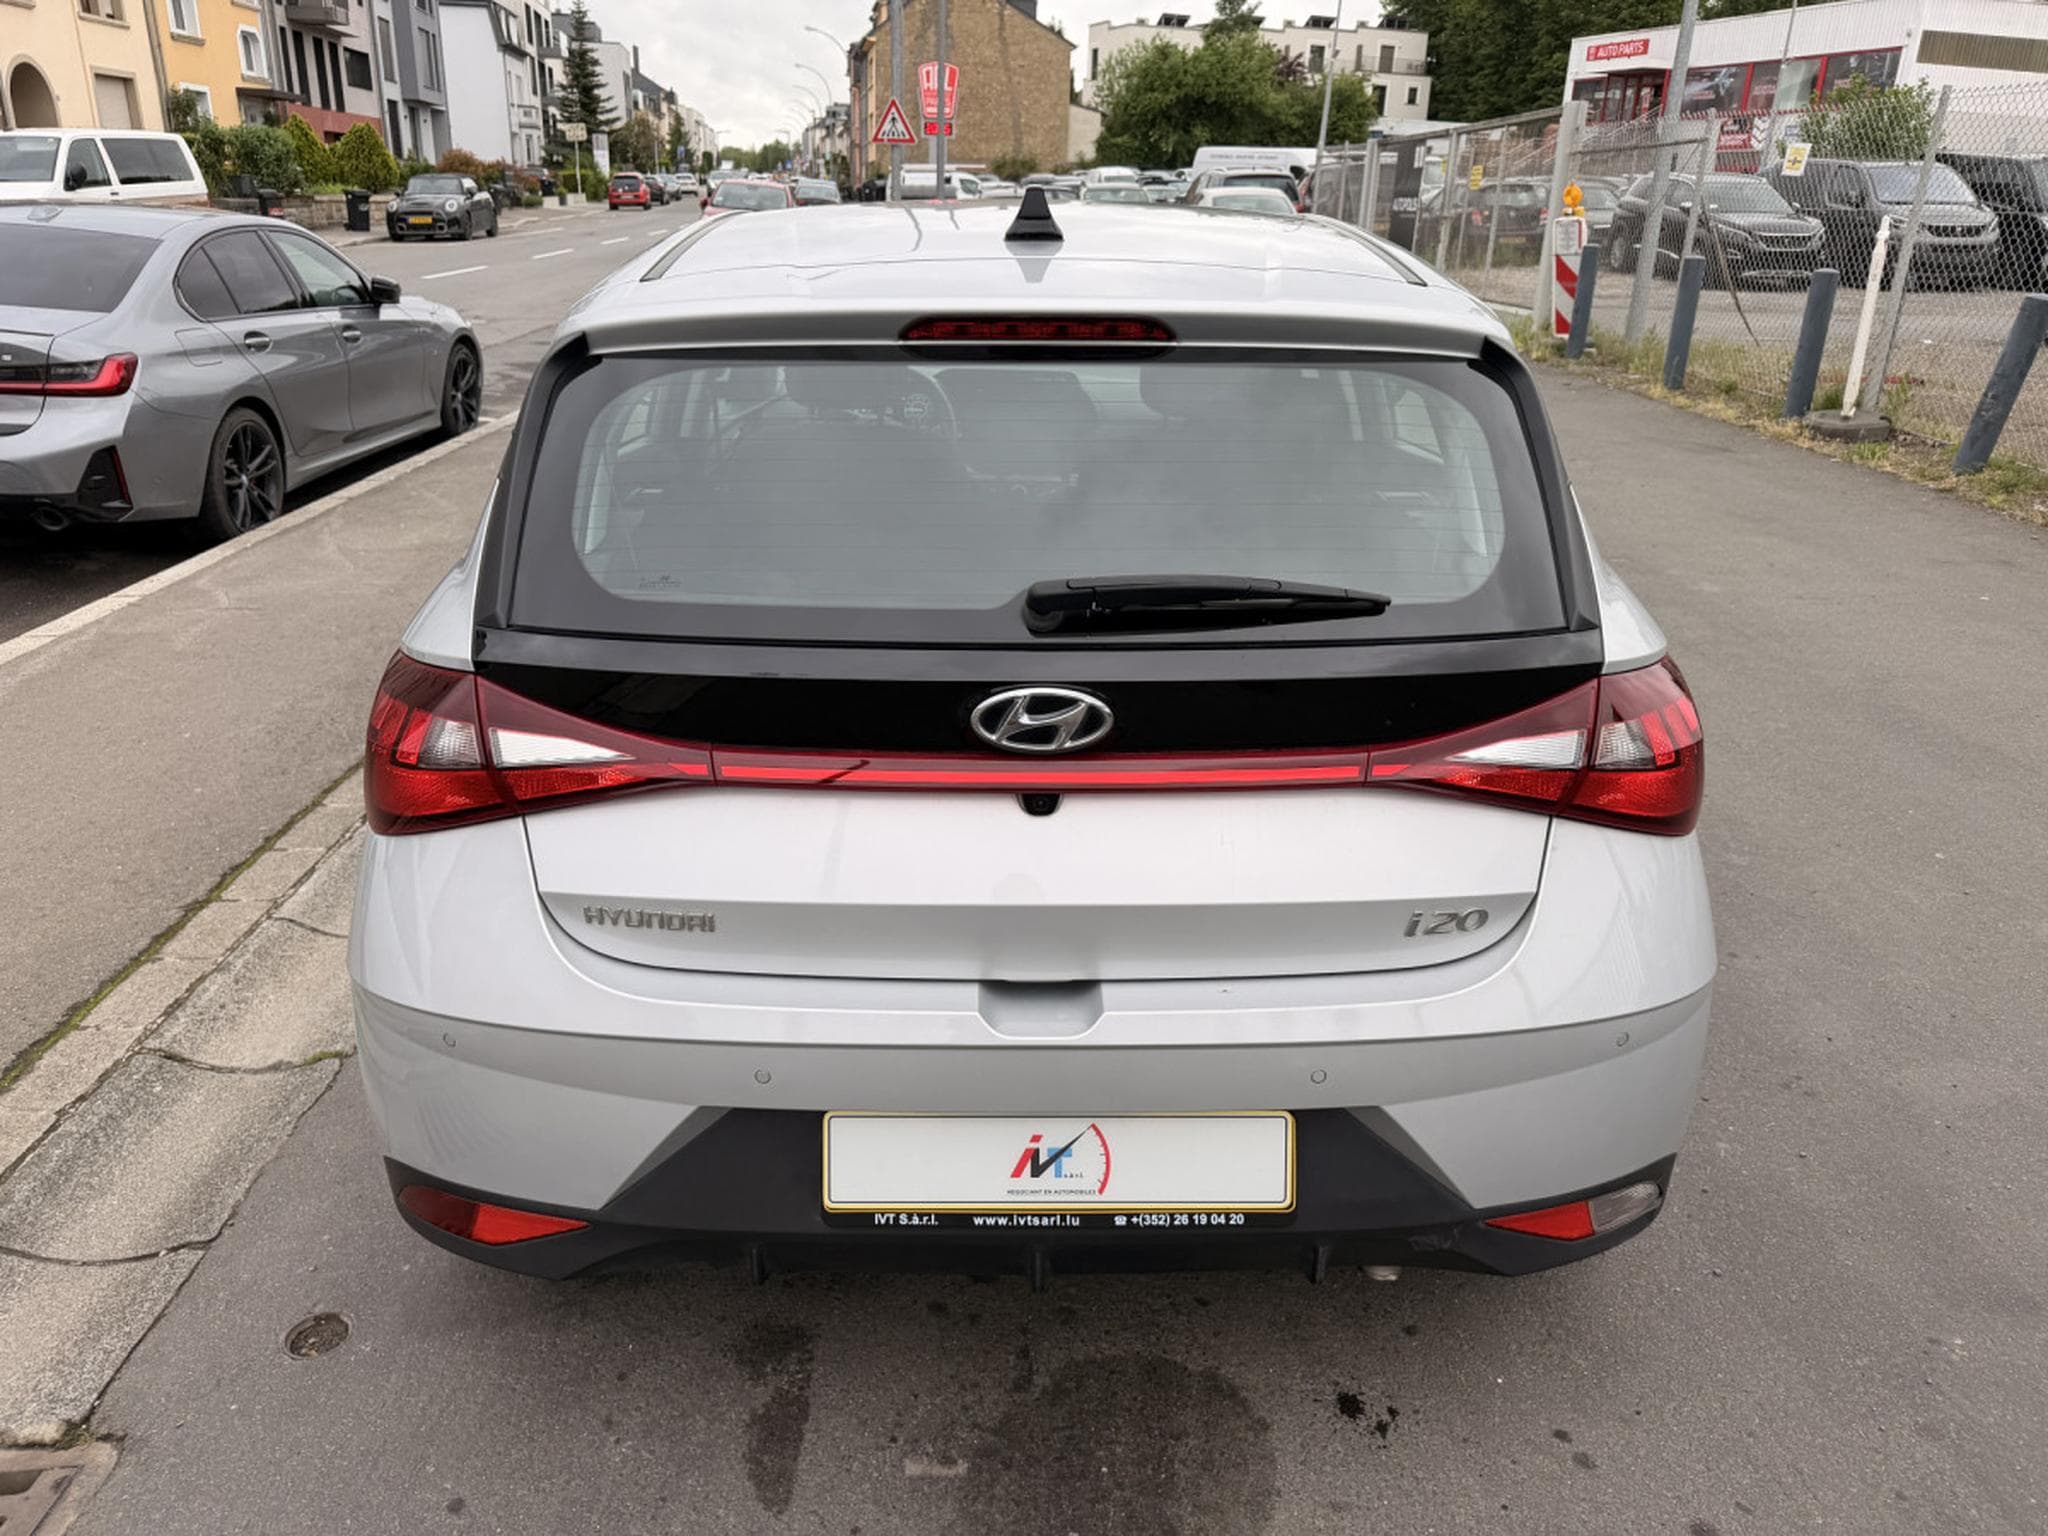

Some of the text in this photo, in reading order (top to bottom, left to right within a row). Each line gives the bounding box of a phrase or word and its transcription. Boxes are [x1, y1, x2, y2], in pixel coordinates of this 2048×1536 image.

[1597, 45, 1618, 57] AUTO
[1619, 41, 1644, 55] PARTS
[583, 906, 716, 933] HYUNDAI
[1403, 907, 1489, 937] i20
[874, 1214, 895, 1225] IVT
[973, 1214, 1080, 1226] www.ivtsarl.lu
[1131, 1213, 1170, 1227] +(352)
[1174, 1214, 1189, 1225] 26
[1193, 1214, 1208, 1225] 19
[1211, 1214, 1226, 1225] 04
[1229, 1213, 1245, 1225] 20
